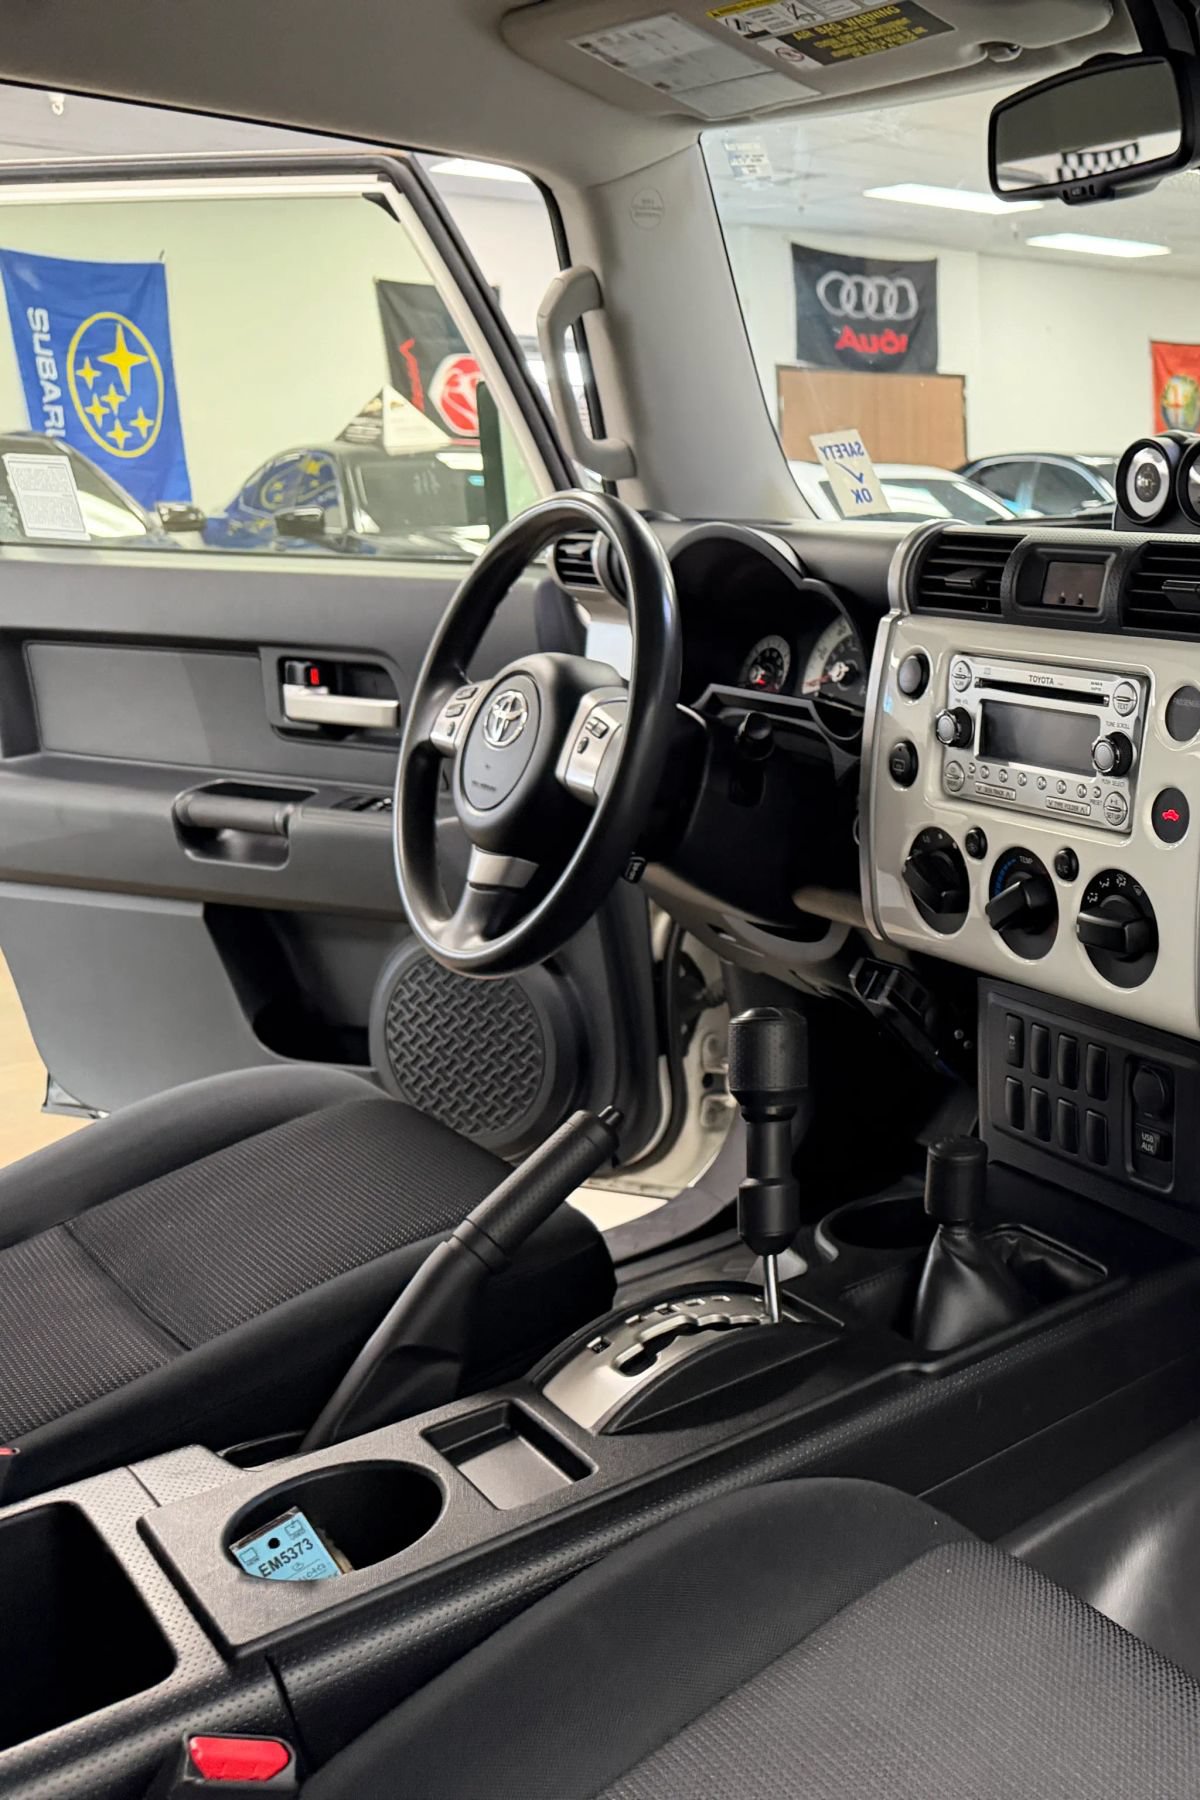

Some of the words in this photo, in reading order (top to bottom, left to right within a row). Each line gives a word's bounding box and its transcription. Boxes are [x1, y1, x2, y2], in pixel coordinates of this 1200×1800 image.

[844, 5, 901, 27] WARNING
[834, 324, 909, 355] Audi
[1029, 674, 1054, 686] TOYOTA
[1019, 855, 1034, 866] TEMP
[1141, 1131, 1154, 1143] USB
[258, 1537, 314, 1578] EM5373
